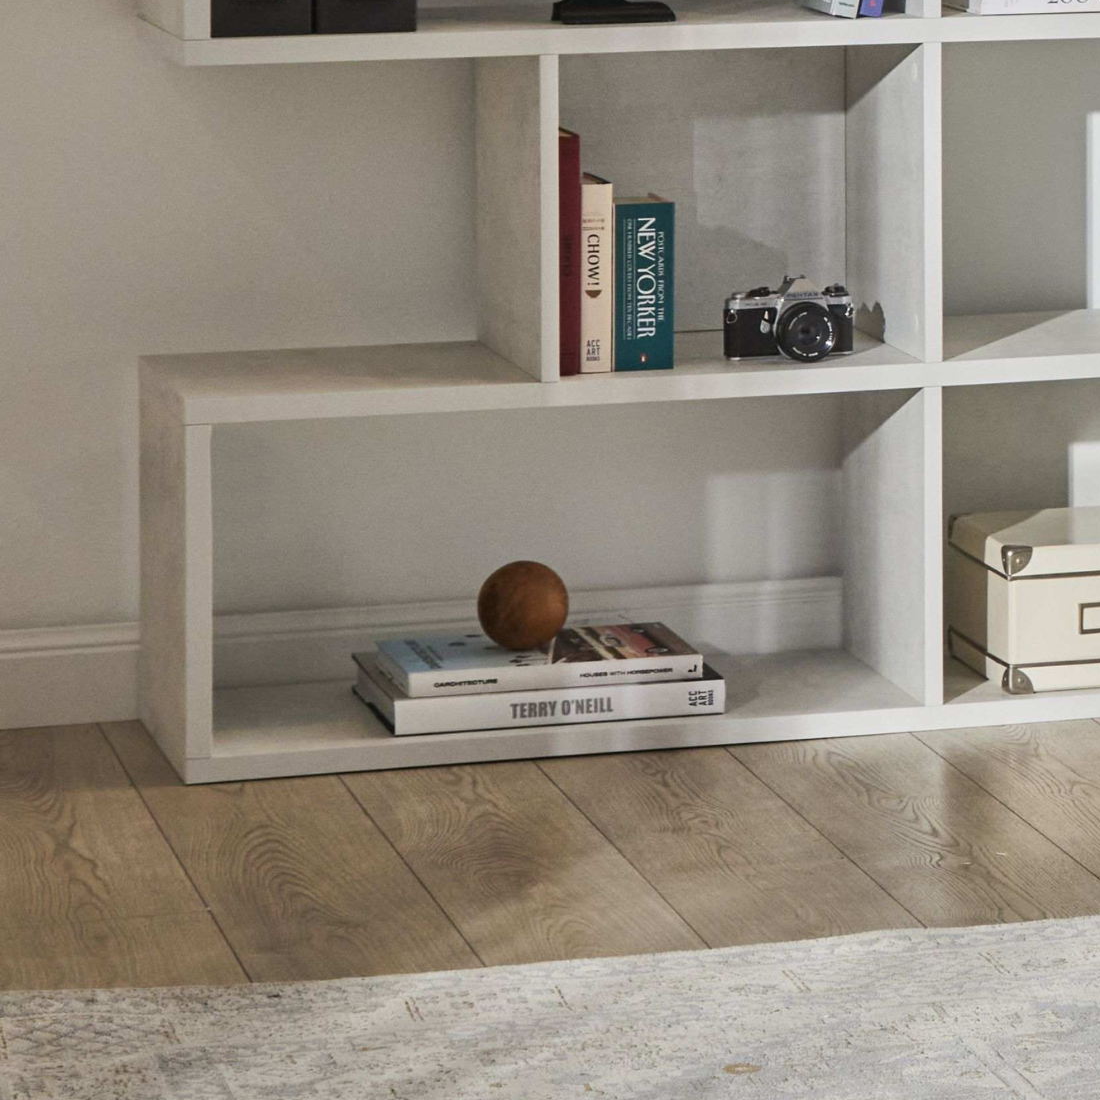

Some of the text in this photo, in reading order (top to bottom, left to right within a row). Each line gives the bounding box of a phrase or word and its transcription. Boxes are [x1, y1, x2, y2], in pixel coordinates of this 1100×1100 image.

[587, 234, 600, 286] CHOW!
[636, 217, 657, 339] NEW YORKER
[657, 232, 665, 321] POSTCARDS FROM THE
[587, 340, 600, 348] ACC
[587, 348, 600, 356] ART
[626, 667, 673, 675] HORSEPOWER
[434, 678, 498, 688] CARCHITECTURE
[688, 690, 697, 706] ACC
[698, 690, 707, 706] ART
[510, 697, 614, 719] TERRY O'NEILL
